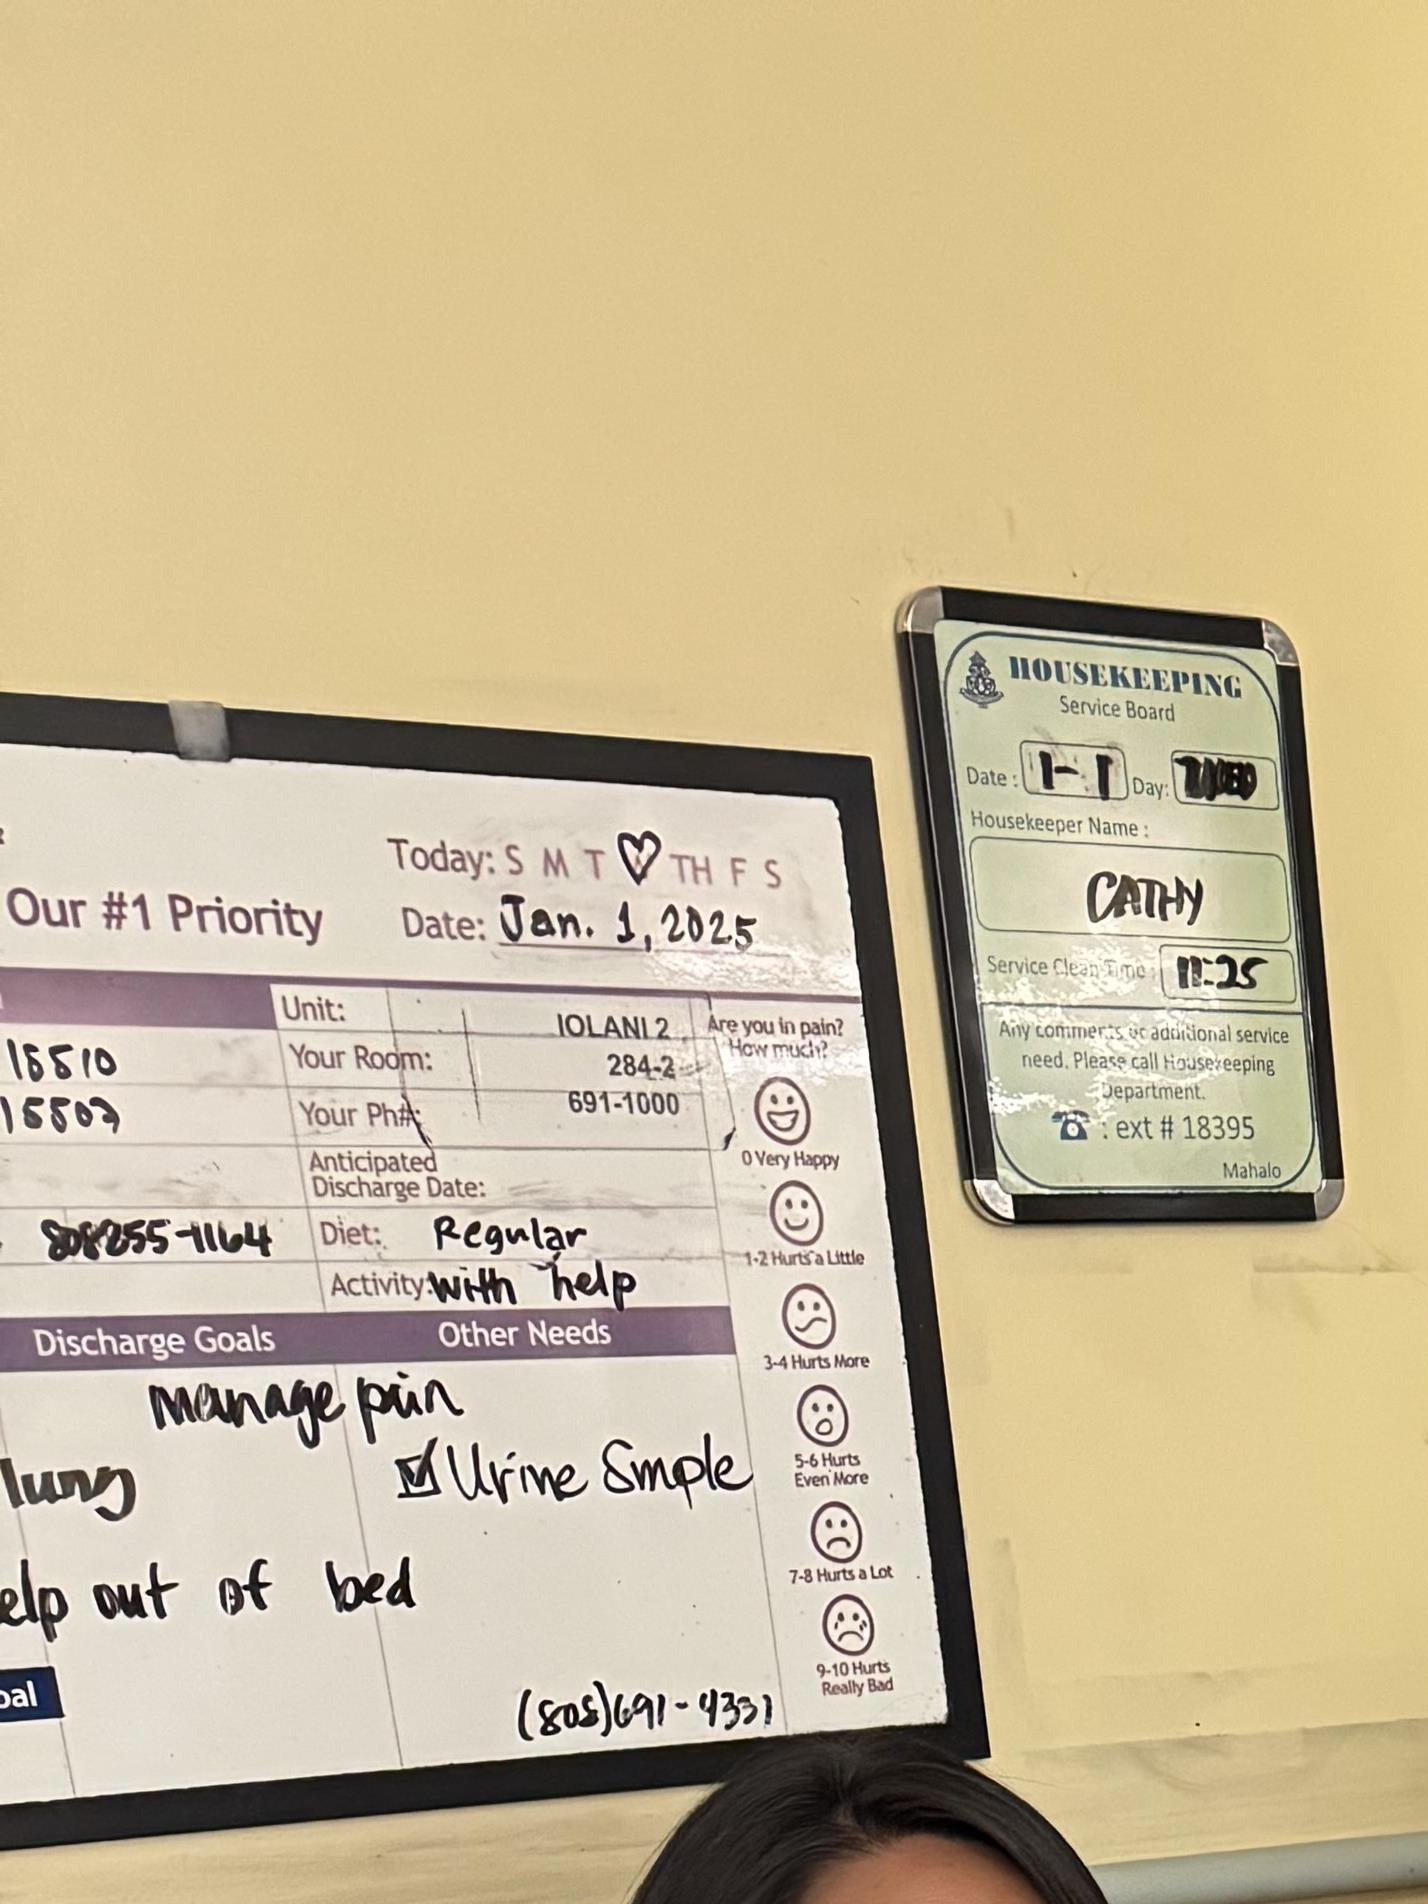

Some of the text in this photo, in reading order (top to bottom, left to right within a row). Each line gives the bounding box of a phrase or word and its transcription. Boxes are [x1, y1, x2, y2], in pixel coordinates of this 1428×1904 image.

[1008, 655, 1243, 699] HOUSEKEEPING
[1059, 695, 1176, 723] Service Board
[966, 766, 1007, 788] Date
[1133, 776, 1169, 800] Day:
[971, 811, 1085, 837] Housekeeper
[1090, 817, 1137, 837] Name
[387, 838, 495, 881] Today:
[505, 845, 524, 876] S
[543, 848, 570, 879] M
[584, 849, 606, 880] T
[670, 854, 714, 886] TH
[730, 857, 747, 887] F
[765, 859, 783, 889] S
[1086, 870, 1204, 926] CATHY
[7, 886, 324, 946] Our #1 Priority
[402, 906, 487, 941] Date:
[500, 894, 595, 945] Jan.
[661, 903, 757, 952] 2025
[988, 955, 1048, 975] Service
[1053, 958, 1098, 977] Clean
[281, 996, 671, 1040] Unit: IOLANI 2
[708, 1015, 844, 1041] Are you in pain?
[999, 1021, 1031, 1042] Any
[1151, 1023, 1231, 1042] additional
[1236, 1026, 1290, 1044] service
[288, 1043, 676, 1081] Your Room: 284-2
[729, 1039, 829, 1060] How much?
[1022, 1052, 1275, 1076] need. Please call Housekeeping
[298, 1099, 358, 1128] Your
[569, 1091, 680, 1116] 691-1000
[1116, 1118, 1157, 1140] ext
[1161, 1117, 1176, 1139] #
[1183, 1115, 1255, 1142] 18395
[309, 1150, 437, 1178] Anticipated
[742, 1150, 840, 1171] 0 Very Happy
[1223, 1161, 1282, 1182] Mahalo
[312, 1175, 486, 1204] Discharge Date:
[321, 1215, 588, 1255] Diet: Regular
[745, 1249, 865, 1266] 1-2 Hurts a Little
[330, 1254, 637, 1312] Activity: with help
[33, 1318, 612, 1360] Discharge Goals Other Needs
[764, 1353, 870, 1370] 3-4 Hurts More
[446, 1442, 589, 1505] Urine
[794, 1452, 861, 1468] 5-6 Hurts
[794, 1470, 869, 1488] Even More
[789, 1568, 813, 1583] 7-8
[817, 1567, 856, 1583] Hurts
[870, 1565, 894, 1581] Lot
[0, 1556, 417, 1643] elp out of bed
[817, 1659, 891, 1677] 9-10 Hurts
[0, 1678, 38, 1709] oal
[821, 1678, 894, 1698] Really Bad
